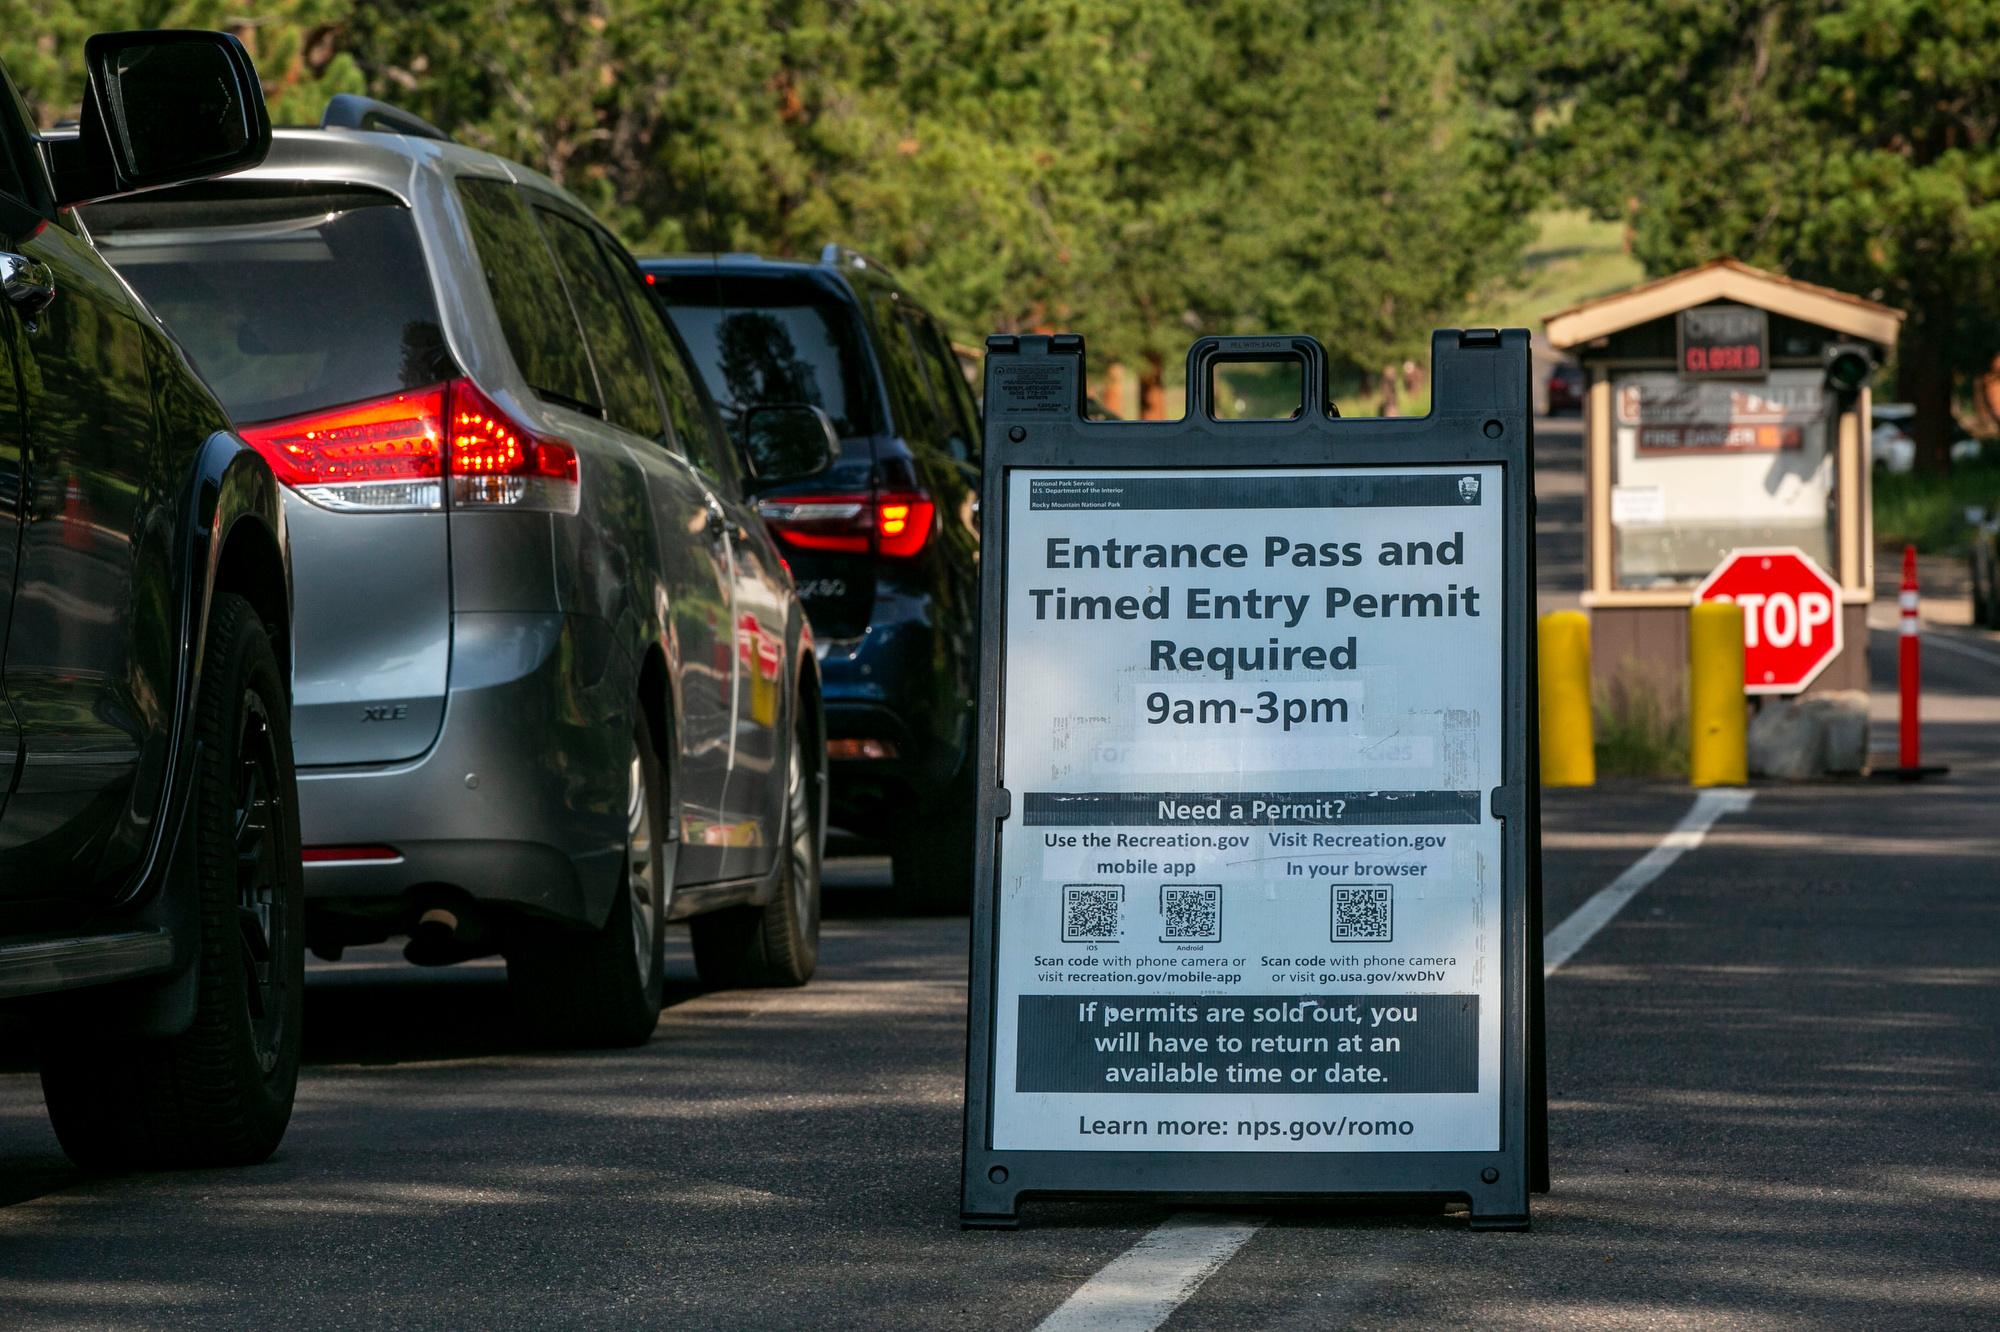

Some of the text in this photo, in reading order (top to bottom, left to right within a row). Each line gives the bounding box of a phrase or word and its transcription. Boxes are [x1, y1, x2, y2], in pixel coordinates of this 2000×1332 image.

[1686, 345, 1760, 370] CLOSED
[1643, 430, 1680, 447] FIRE
[1047, 532, 1463, 568] Entrance Pass and
[1029, 584, 1479, 628] Timed Entry Permit
[1713, 592, 1831, 648] TOP
[1151, 637, 1356, 680] Required
[361, 704, 409, 722] XLE
[1147, 691, 1347, 731] 9am-3pm
[1159, 799, 1345, 820] Need a Permit?
[1045, 833, 1249, 850] Use the Recreation.gov
[1269, 833, 1446, 850] Visit Recreation.gov
[1098, 859, 1195, 877] mobile app
[1287, 861, 1427, 879] In your browser
[1035, 956, 1063, 966] Scan
[1068, 956, 1098, 966] code
[1103, 956, 1131, 966] with
[1137, 956, 1177, 968] phone
[1261, 956, 1290, 966] Scan
[1295, 955, 1325, 966] code
[1330, 955, 1358, 966] with
[1364, 955, 1404, 968] phone
[1038, 972, 1241, 984] visit recreation.gov/mobile-app
[1272, 971, 1444, 984] or visit go.usa.gov/xwDhV
[1080, 1002, 1418, 1027] If permits are sold out, you
[1095, 1032, 1400, 1052] will have to return at an
[1106, 1063, 1387, 1082] available time or date.
[1080, 1116, 1414, 1140] Learn more: nps.gov/romo
